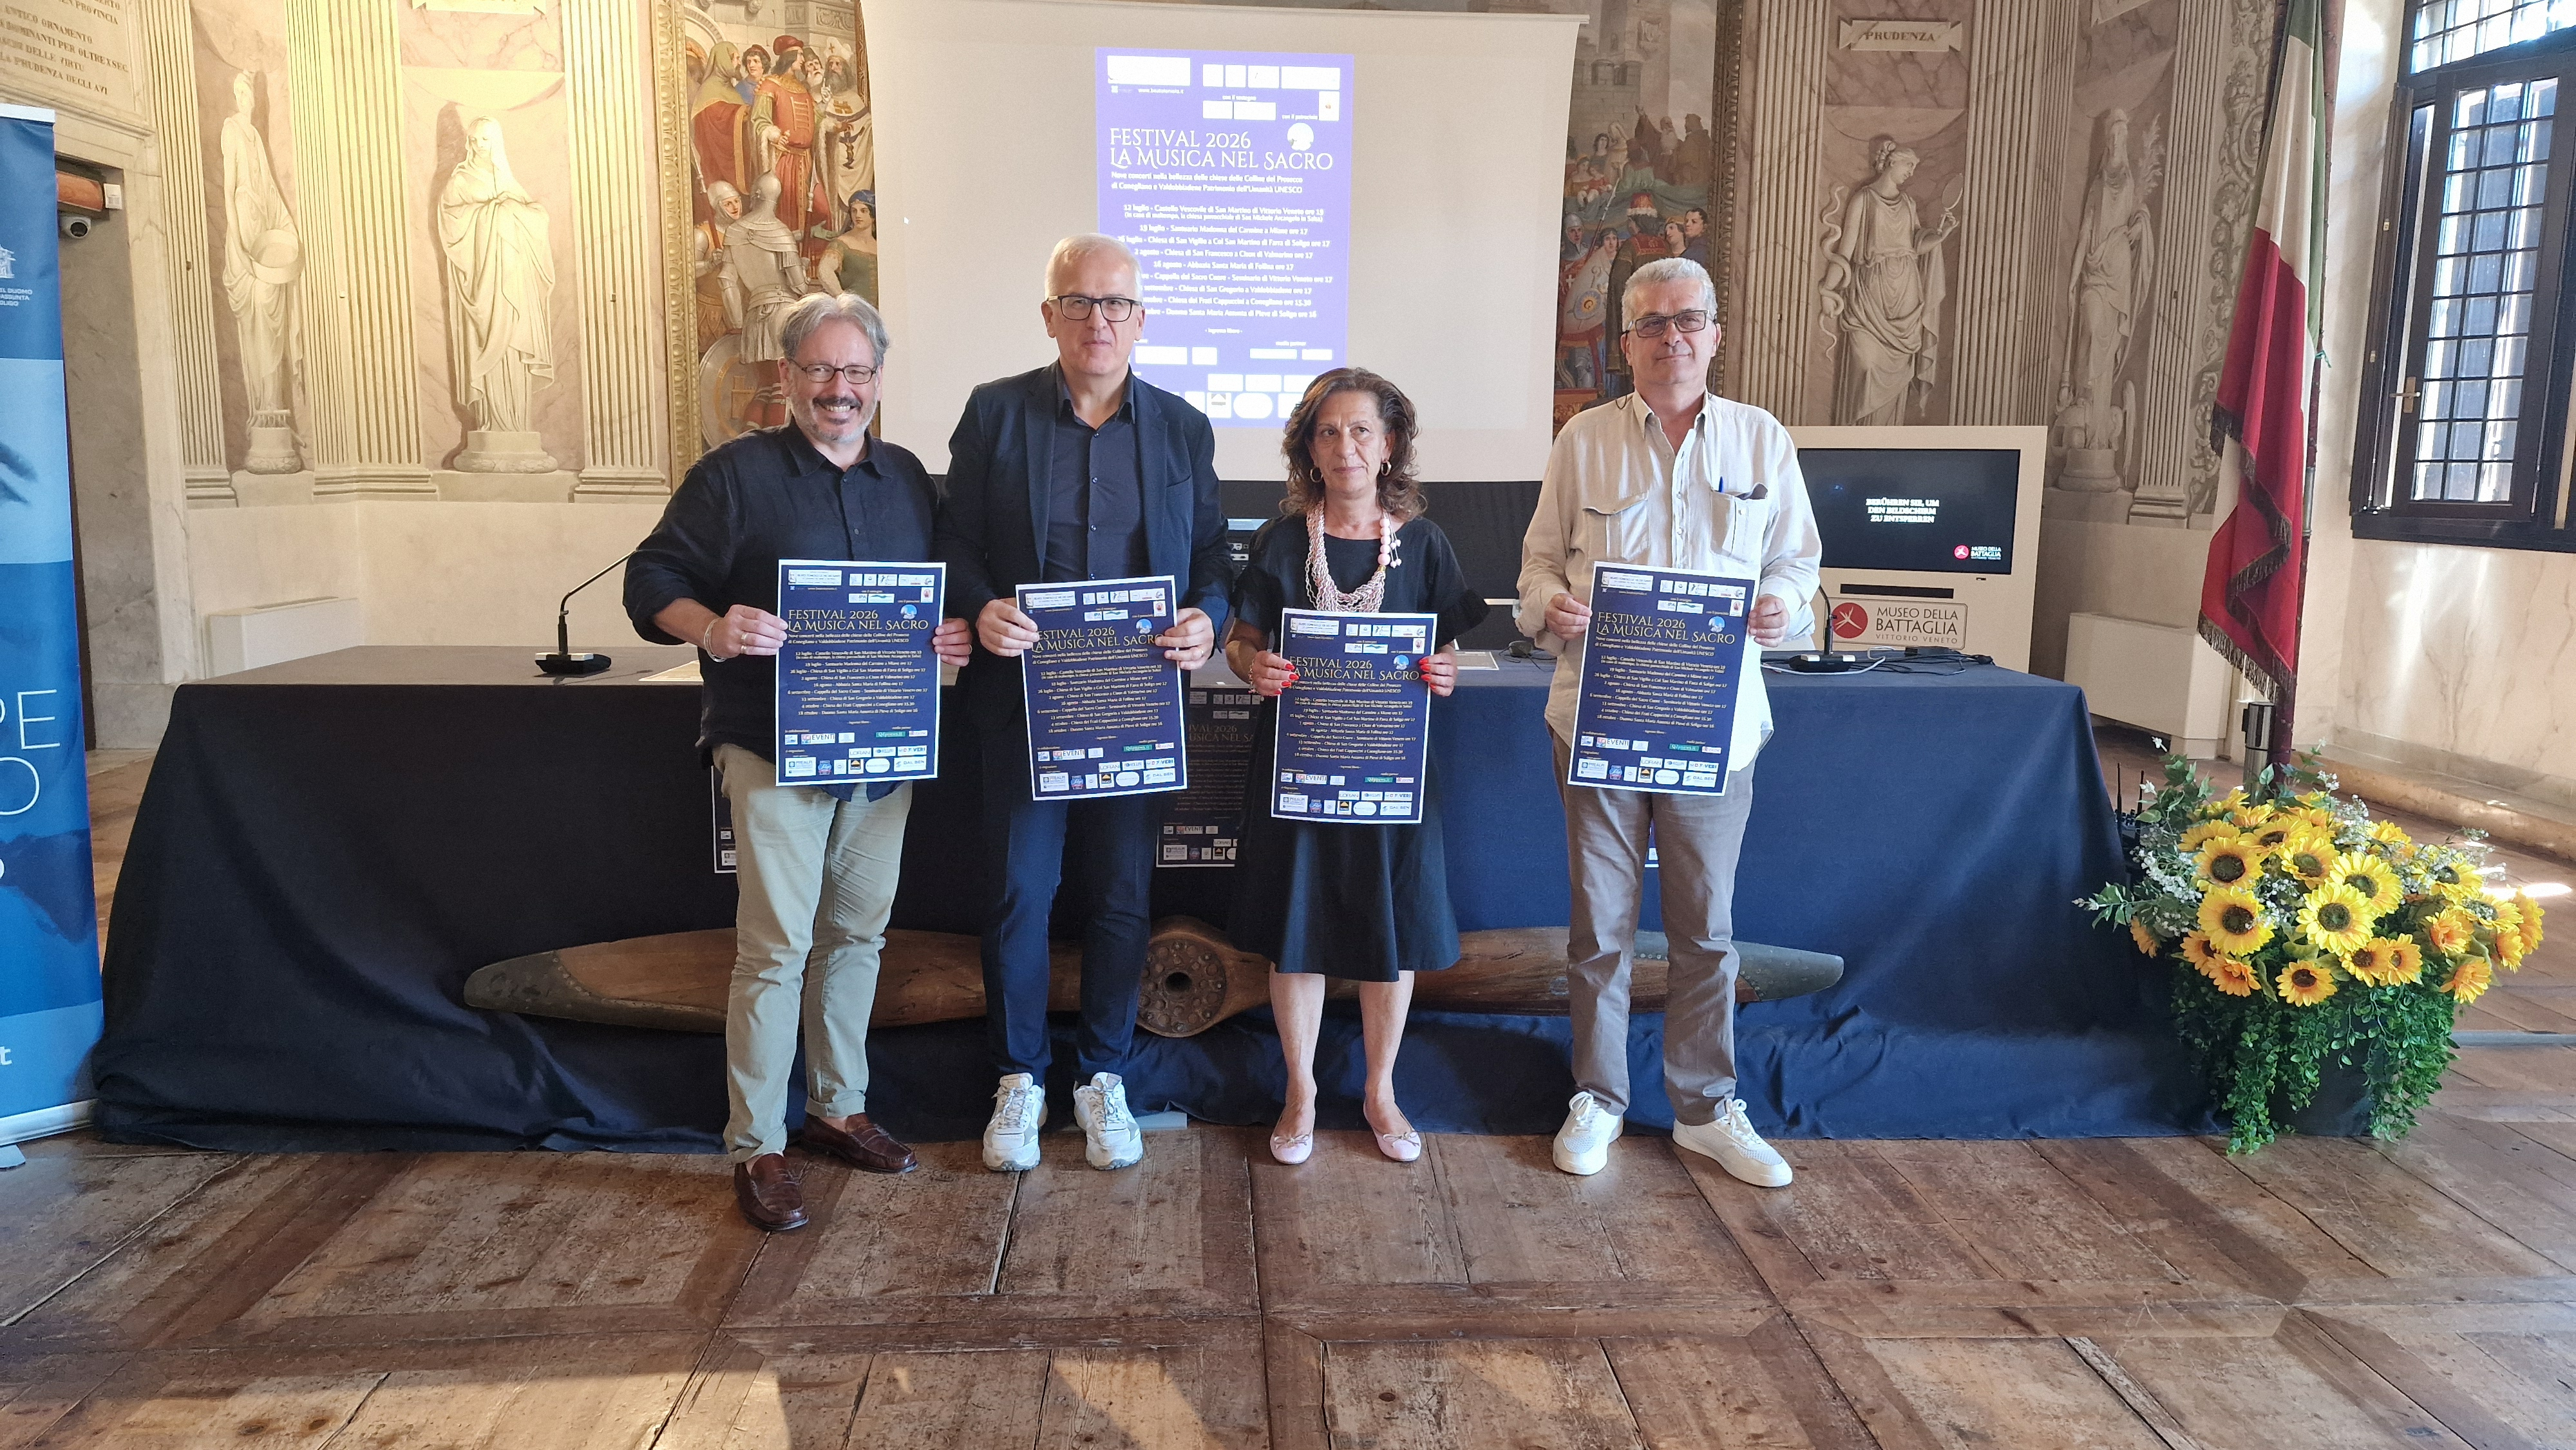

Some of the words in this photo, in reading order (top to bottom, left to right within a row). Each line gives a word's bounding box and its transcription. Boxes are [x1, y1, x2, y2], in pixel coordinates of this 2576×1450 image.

[41, 18, 92, 44] ORNAMENTO
[1864, 32, 1935, 41] PRUDENZA
[26, 44, 55, 62] DELLE
[58, 39, 76, 53] PER
[1110, 128, 1200, 147] FESTIVAL
[1206, 131, 1251, 149] 2026
[1110, 147, 1132, 169] LA
[1135, 146, 1215, 169] MUSICA
[1221, 151, 1258, 168] NEL
[1264, 151, 1333, 170] SACRO
[788, 609, 846, 619] FESTIVAL
[849, 609, 878, 619] 2026
[1598, 612, 1654, 626] FESTIVAL
[1657, 618, 1685, 629] 2026
[1877, 607, 1919, 618] MUSEO
[1924, 608, 1958, 620] DELLA
[788, 620, 802, 632] LA
[805, 620, 855, 632] MUSICA
[858, 620, 882, 630] NEL
[886, 620, 929, 631] SACRO
[1876, 618, 1958, 635] BATTAGLIA
[1039, 628, 1084, 641] ESTIVAL
[1087, 627, 1115, 637] 2026
[1596, 623, 1609, 636] LA
[1613, 623, 1662, 638] MUSICA
[1665, 630, 1689, 641] NEL
[1692, 631, 1735, 645] SACRO
[1047, 638, 1094, 652] MUSICA
[1097, 636, 1121, 647] NEL
[1289, 656, 1342, 668] FESTIVAL
[1345, 660, 1372, 669] 2026
[1304, 668, 1352, 680] MUSICA
[1354, 670, 1375, 680] NEL
[1379, 670, 1419, 681] SACRO
